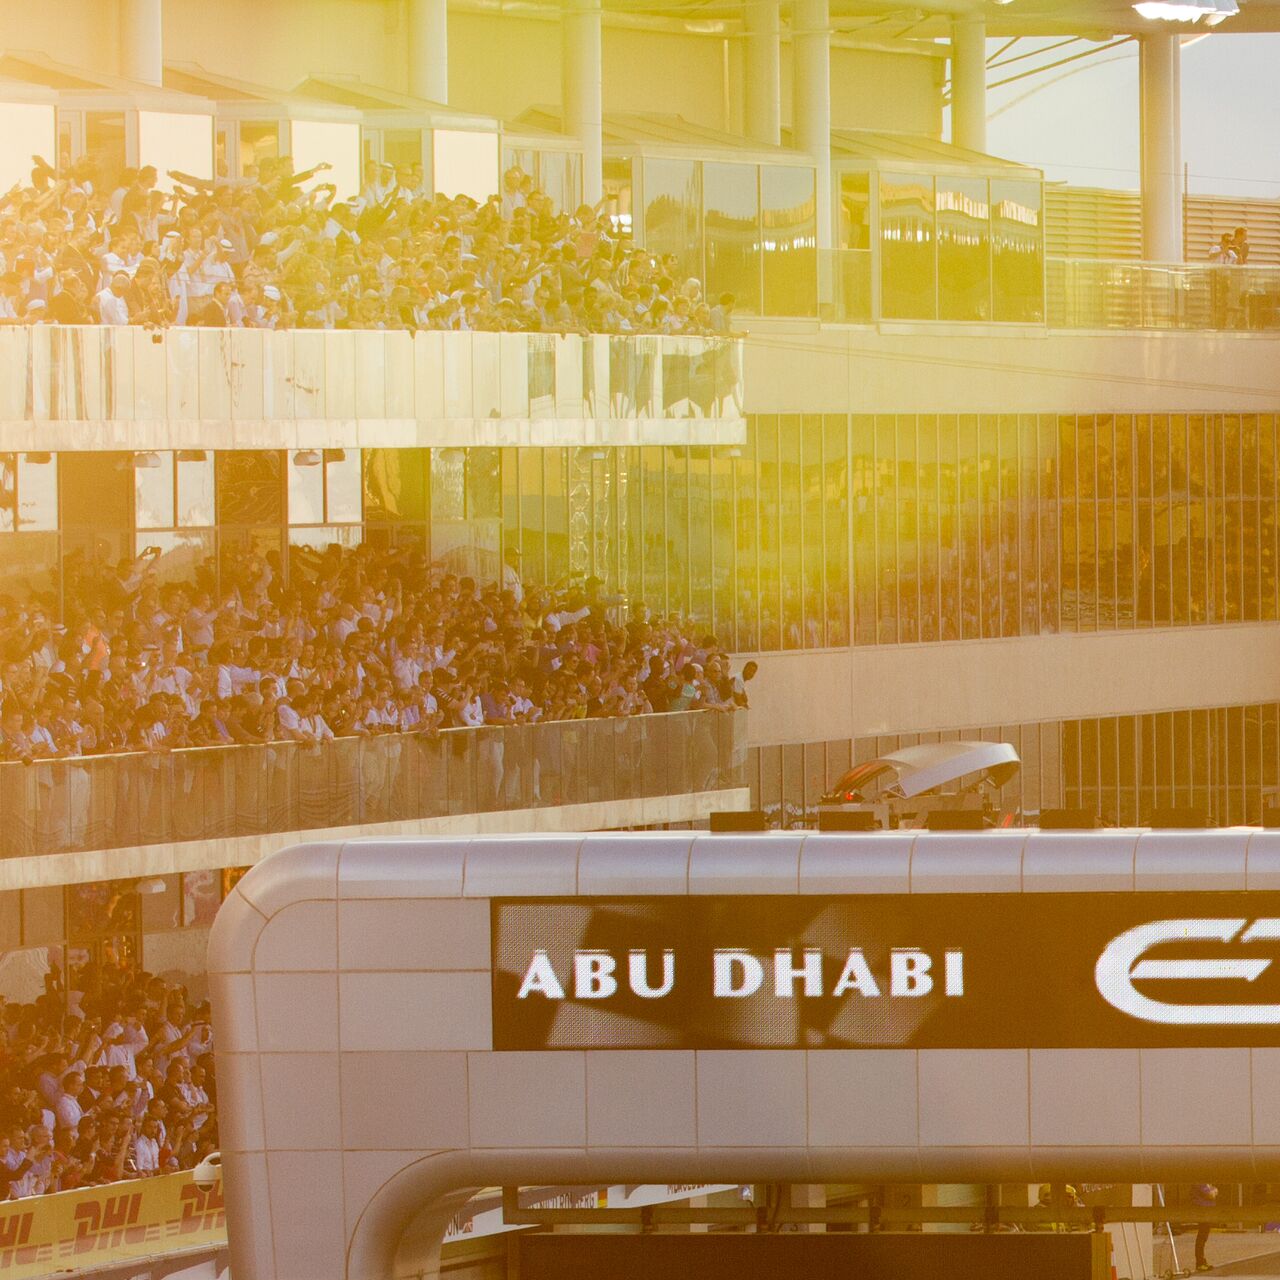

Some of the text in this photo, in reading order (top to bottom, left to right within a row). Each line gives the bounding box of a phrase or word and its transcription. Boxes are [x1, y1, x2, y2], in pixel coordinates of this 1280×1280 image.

[517, 947, 964, 998] ABU DHABI
[74, 1193, 143, 1237] DHL
